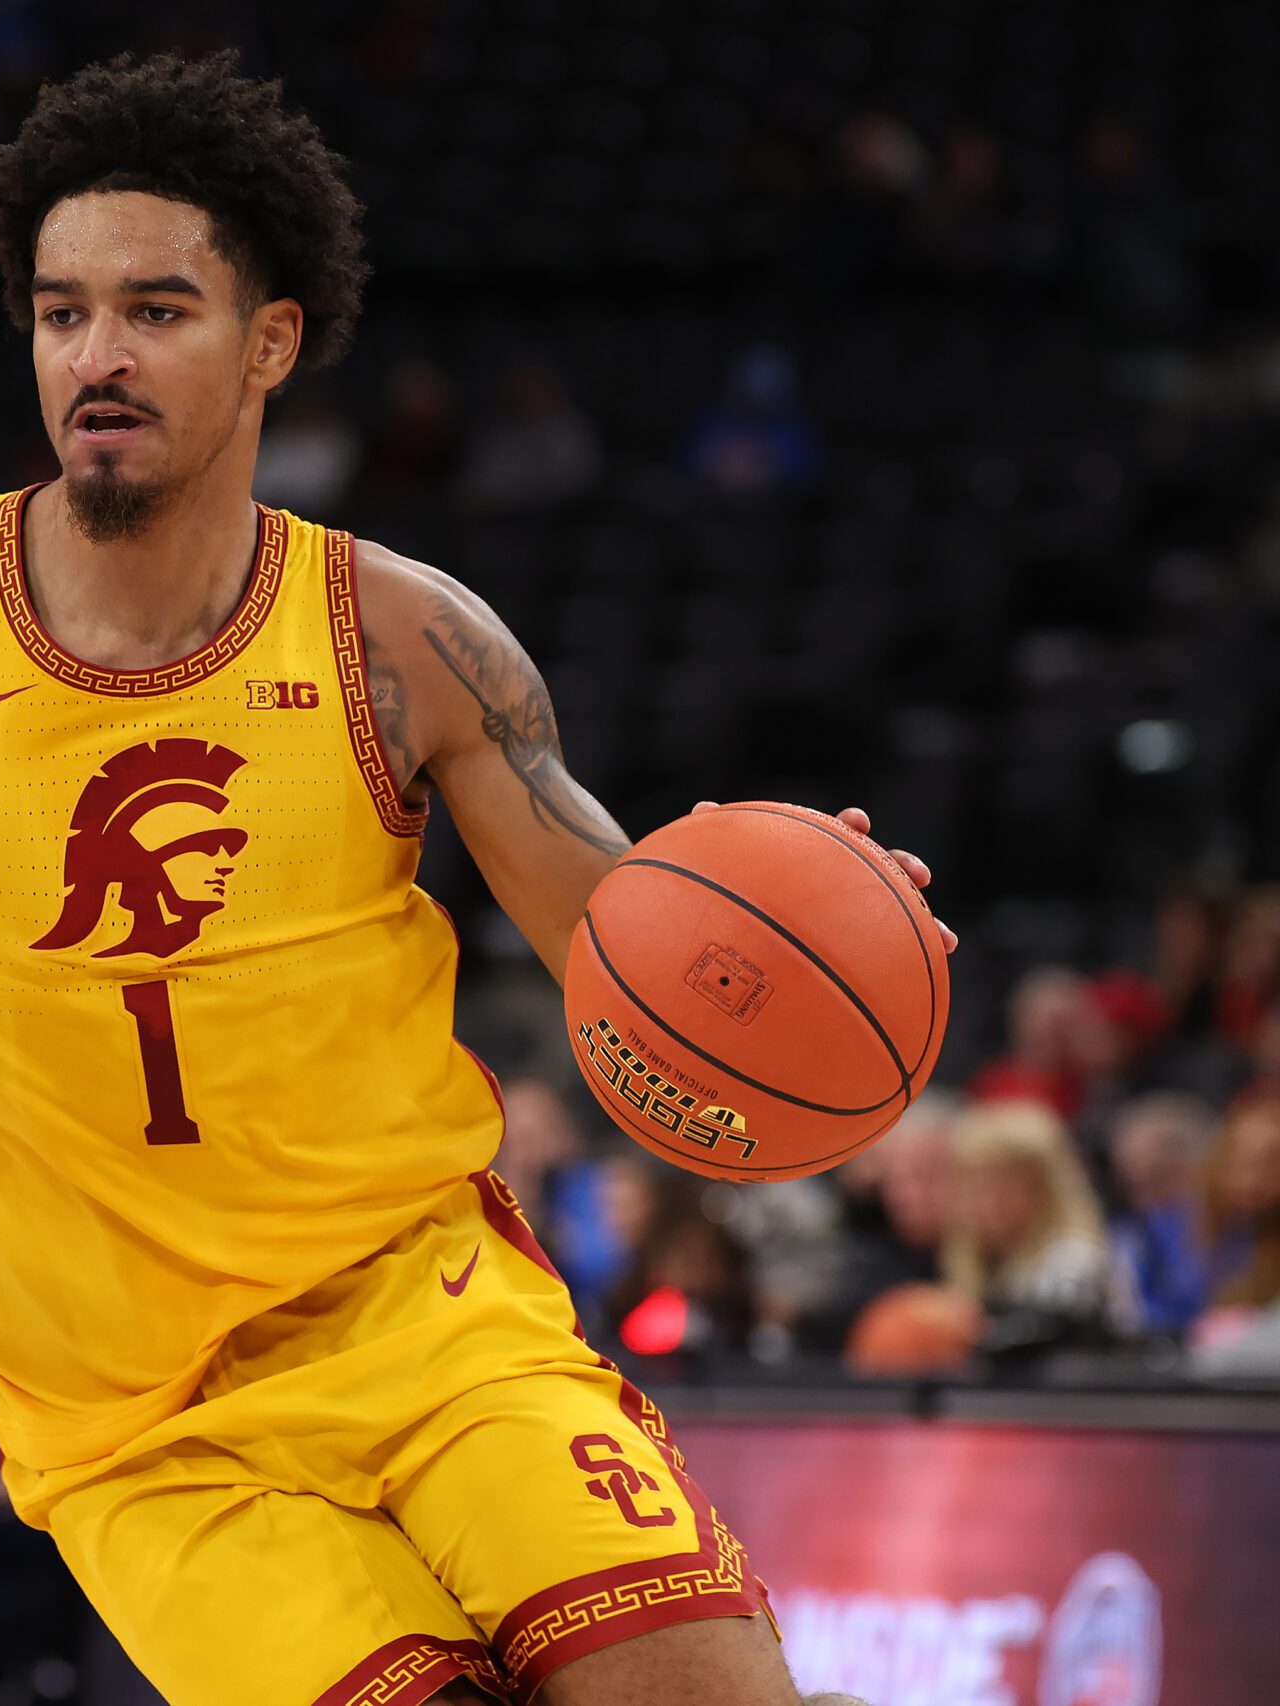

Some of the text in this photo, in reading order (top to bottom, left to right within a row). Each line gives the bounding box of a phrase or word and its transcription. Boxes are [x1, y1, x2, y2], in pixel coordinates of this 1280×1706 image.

[735, 983, 767, 1019] SPALDING
[122, 980, 201, 1146] 1
[578, 1021, 758, 1160] LEGACY
[597, 1017, 699, 1112] 1000
[628, 1027, 719, 1100] OFFICIAL GAME BALL
[569, 1433, 677, 1528] SC
